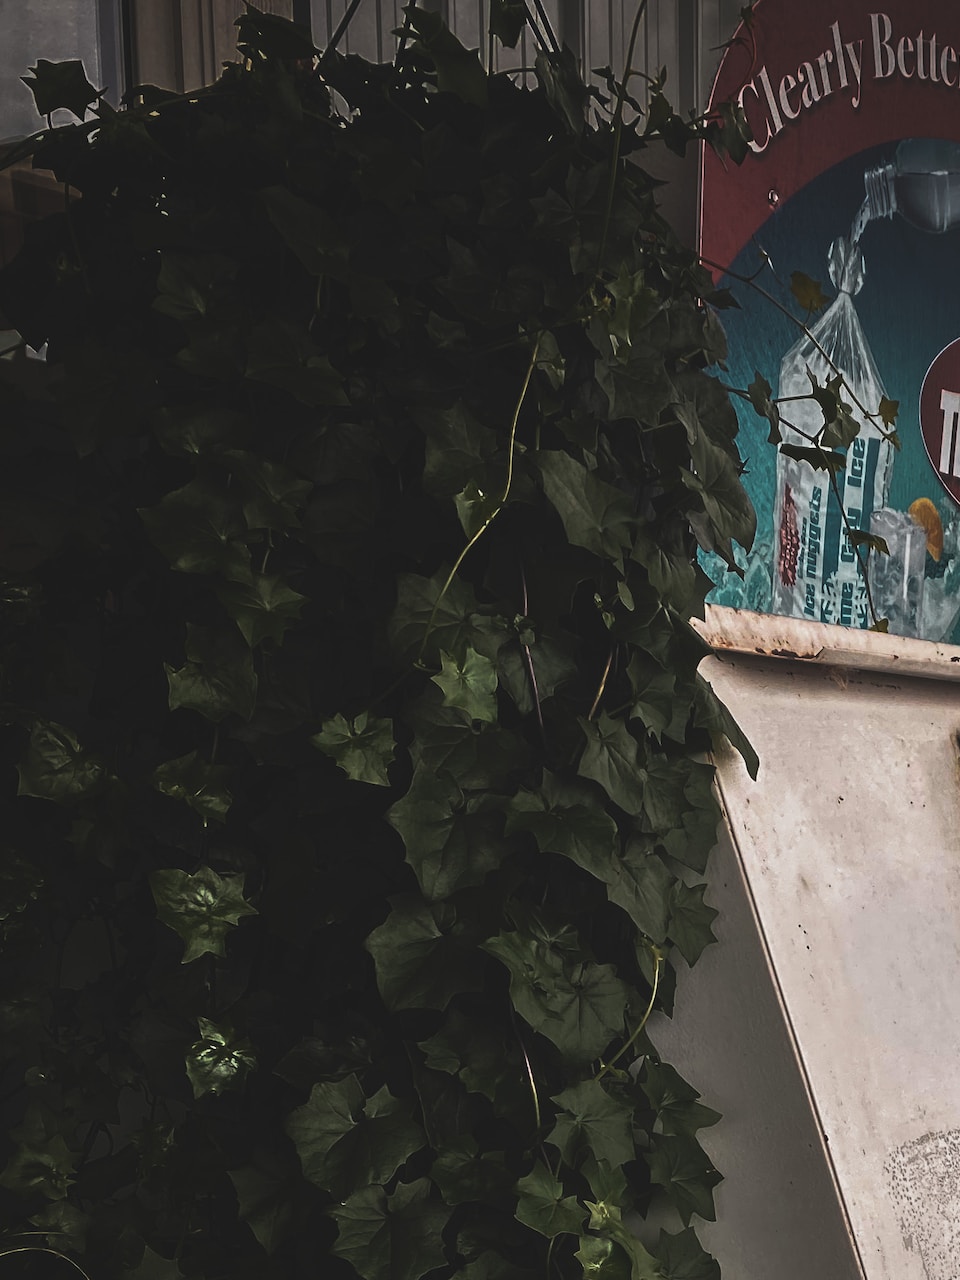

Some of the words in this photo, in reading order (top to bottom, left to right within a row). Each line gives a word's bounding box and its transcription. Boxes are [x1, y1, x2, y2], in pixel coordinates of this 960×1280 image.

[738, 20, 864, 153] Clearly
[847, 437, 866, 487] Ice
[806, 485, 822, 579] nuggets
[803, 583, 816, 617] Ice
